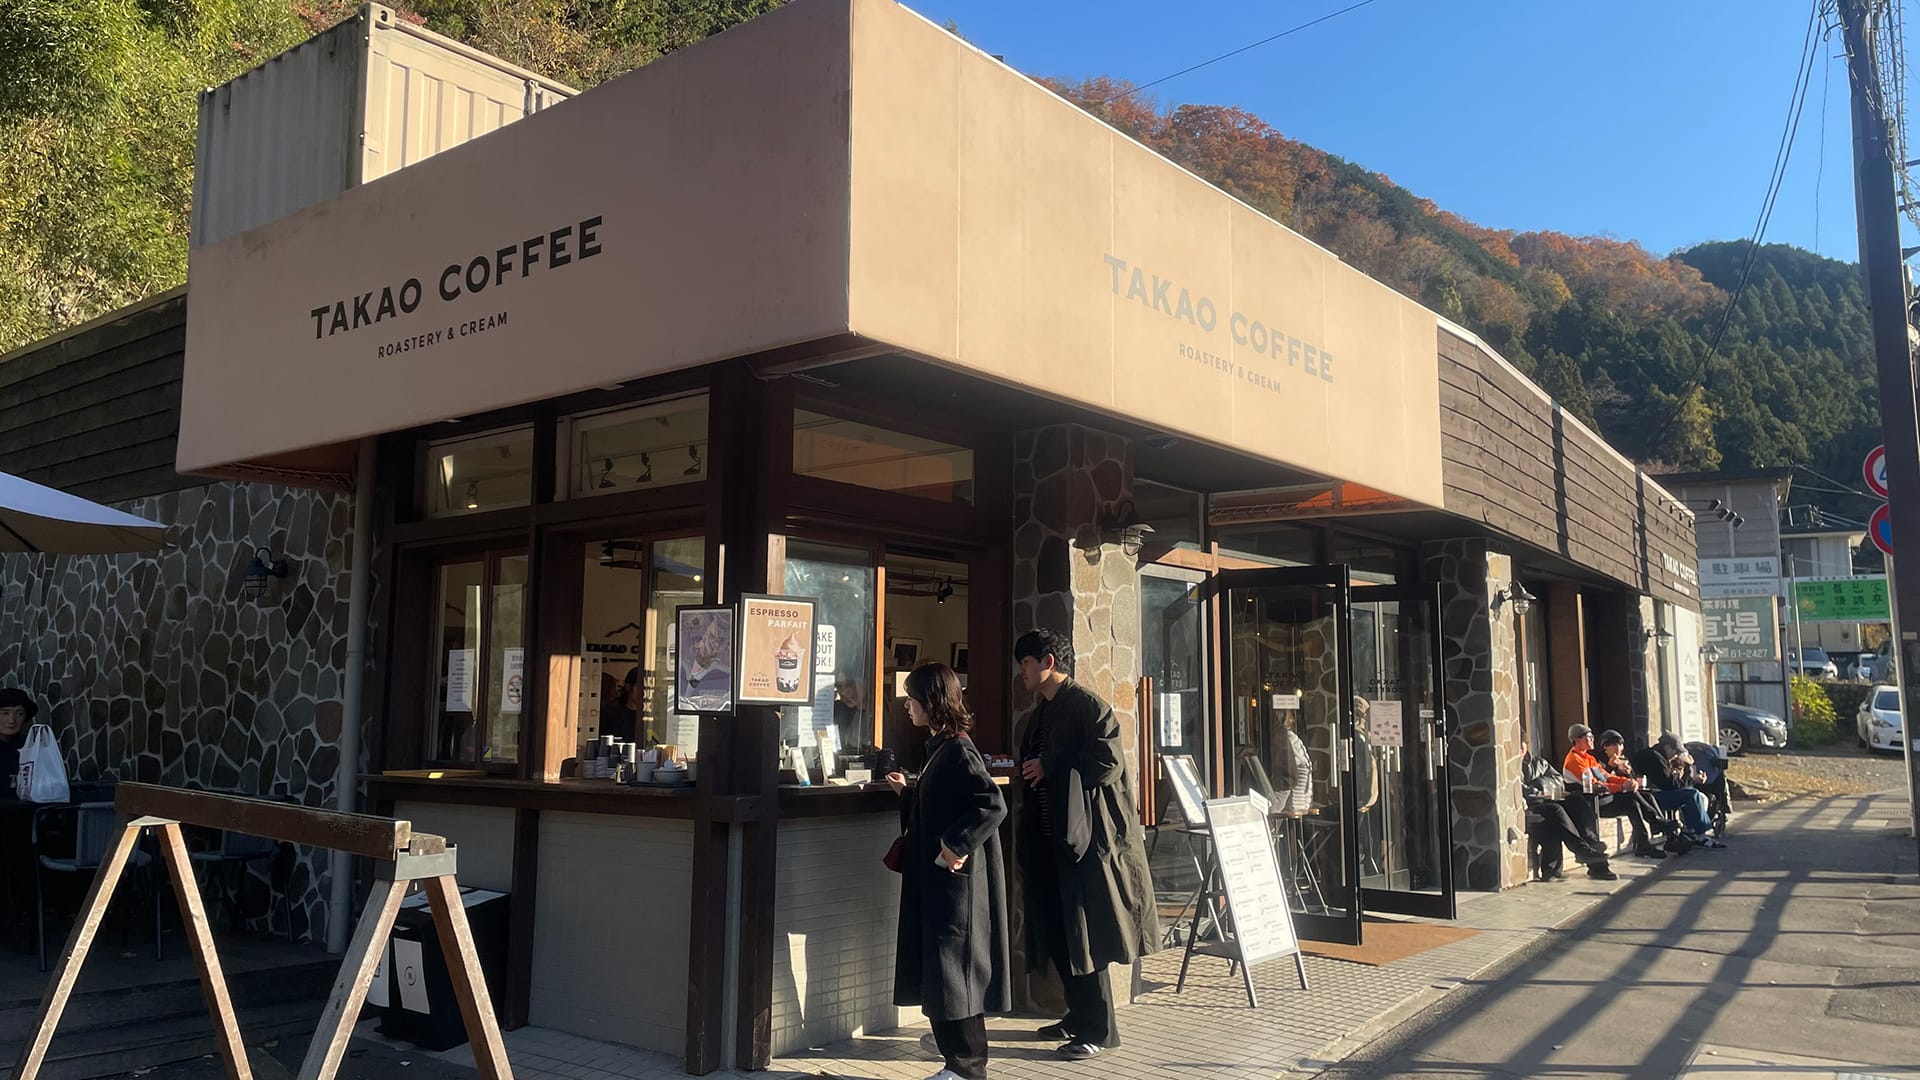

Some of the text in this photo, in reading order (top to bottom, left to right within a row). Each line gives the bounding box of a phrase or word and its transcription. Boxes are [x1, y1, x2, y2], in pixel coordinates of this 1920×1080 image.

[310, 215, 602, 339] TAKAO COFFEE
[378, 311, 508, 359] ROASTERY & CREAM
[1103, 253, 1334, 384] TAKAO COFFEE
[1179, 343, 1281, 394] ROASTERY & CREAM
[750, 607, 799, 618] ESPRESSO
[767, 619, 808, 630] PARFAIT
[816, 631, 833, 643] AKE
